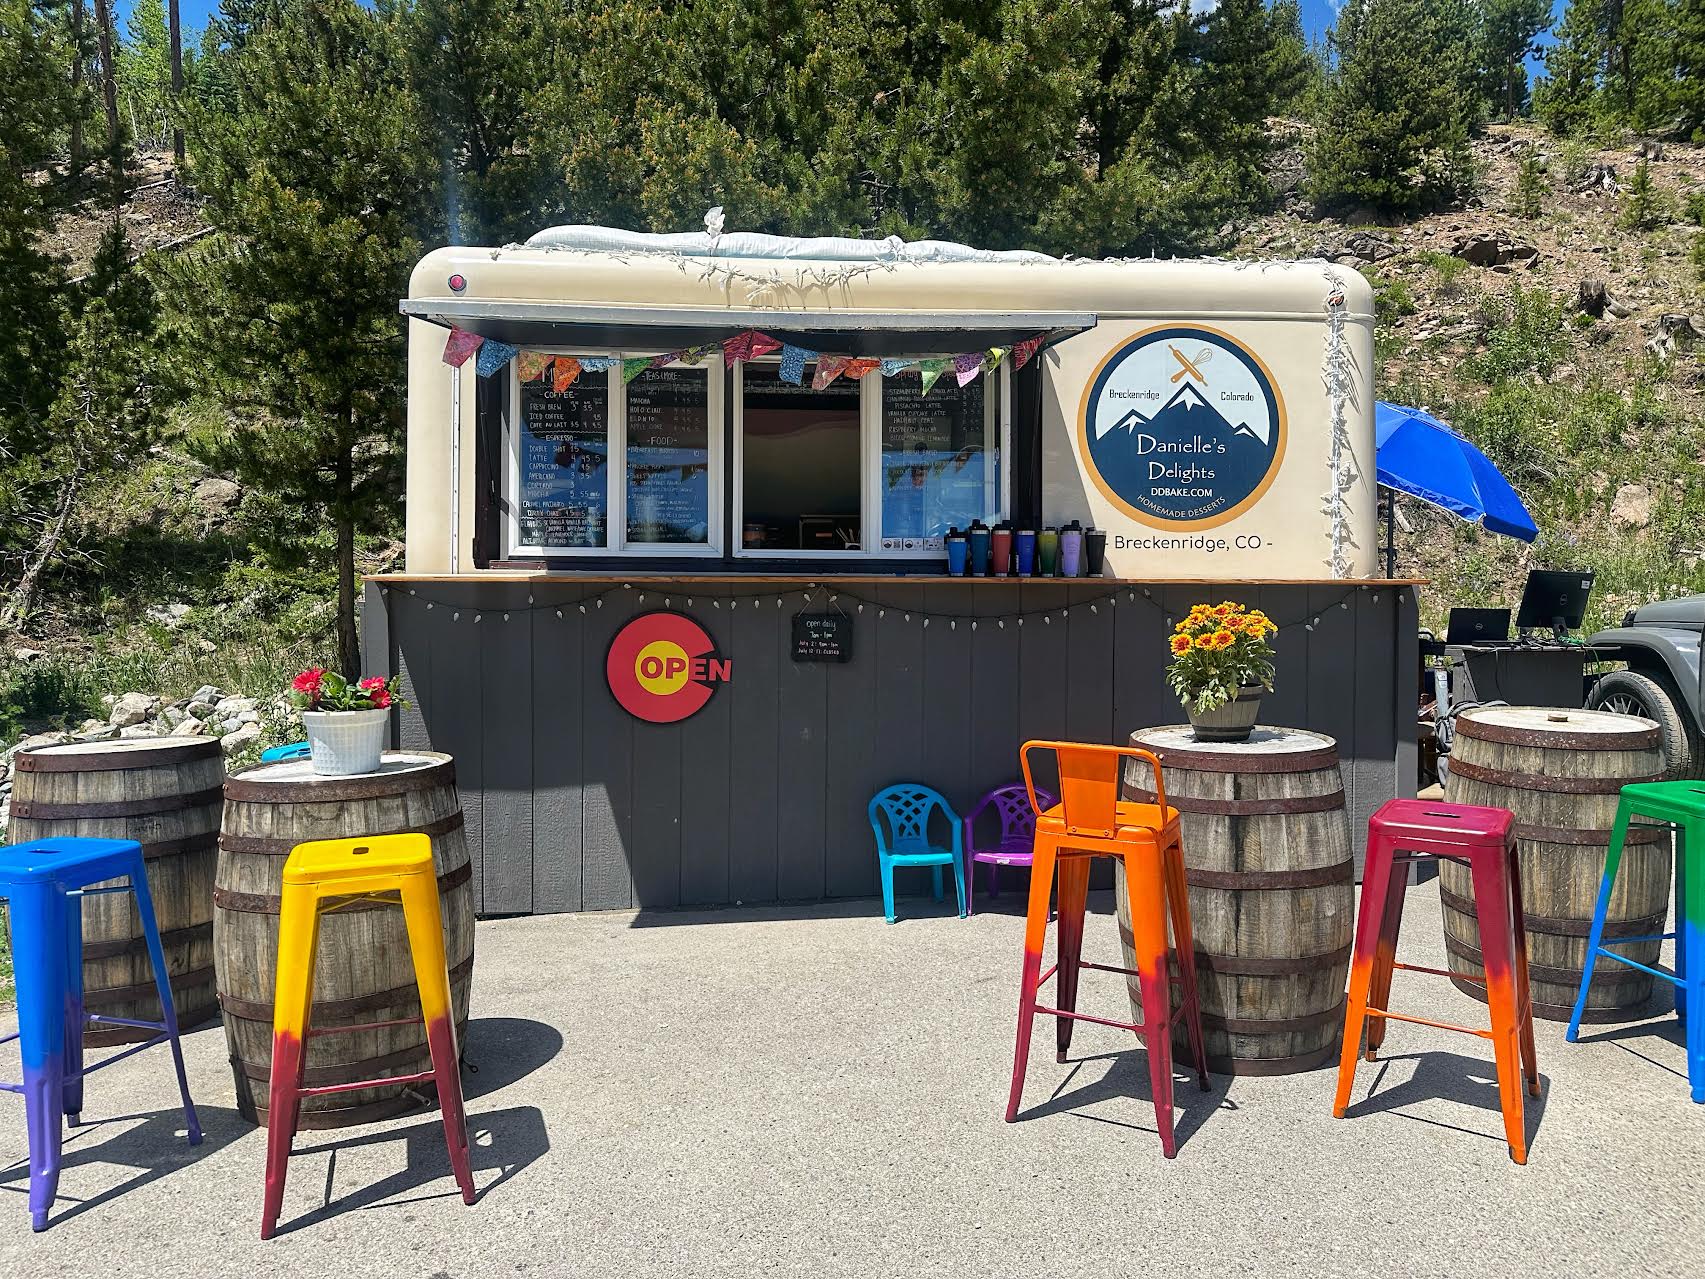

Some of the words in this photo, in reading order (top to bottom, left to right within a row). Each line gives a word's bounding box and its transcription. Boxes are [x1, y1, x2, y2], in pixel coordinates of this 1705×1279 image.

[1109, 389, 1160, 400] Breckenridge
[1220, 391, 1255, 401] Colorado
[547, 403, 562, 411] BREW
[1137, 434, 1226, 455] Danielle's
[1148, 462, 1216, 484] Delights
[1151, 487, 1213, 497] DDBAKE.COM
[1137, 494, 1186, 518] HOMEMADE
[1187, 495, 1226, 518] DESSERTS
[1115, 535, 1230, 552] Breckenridge,
[1235, 535, 1262, 549] CO
[822, 620, 836, 631] daily
[640, 656, 732, 682] OPEN
